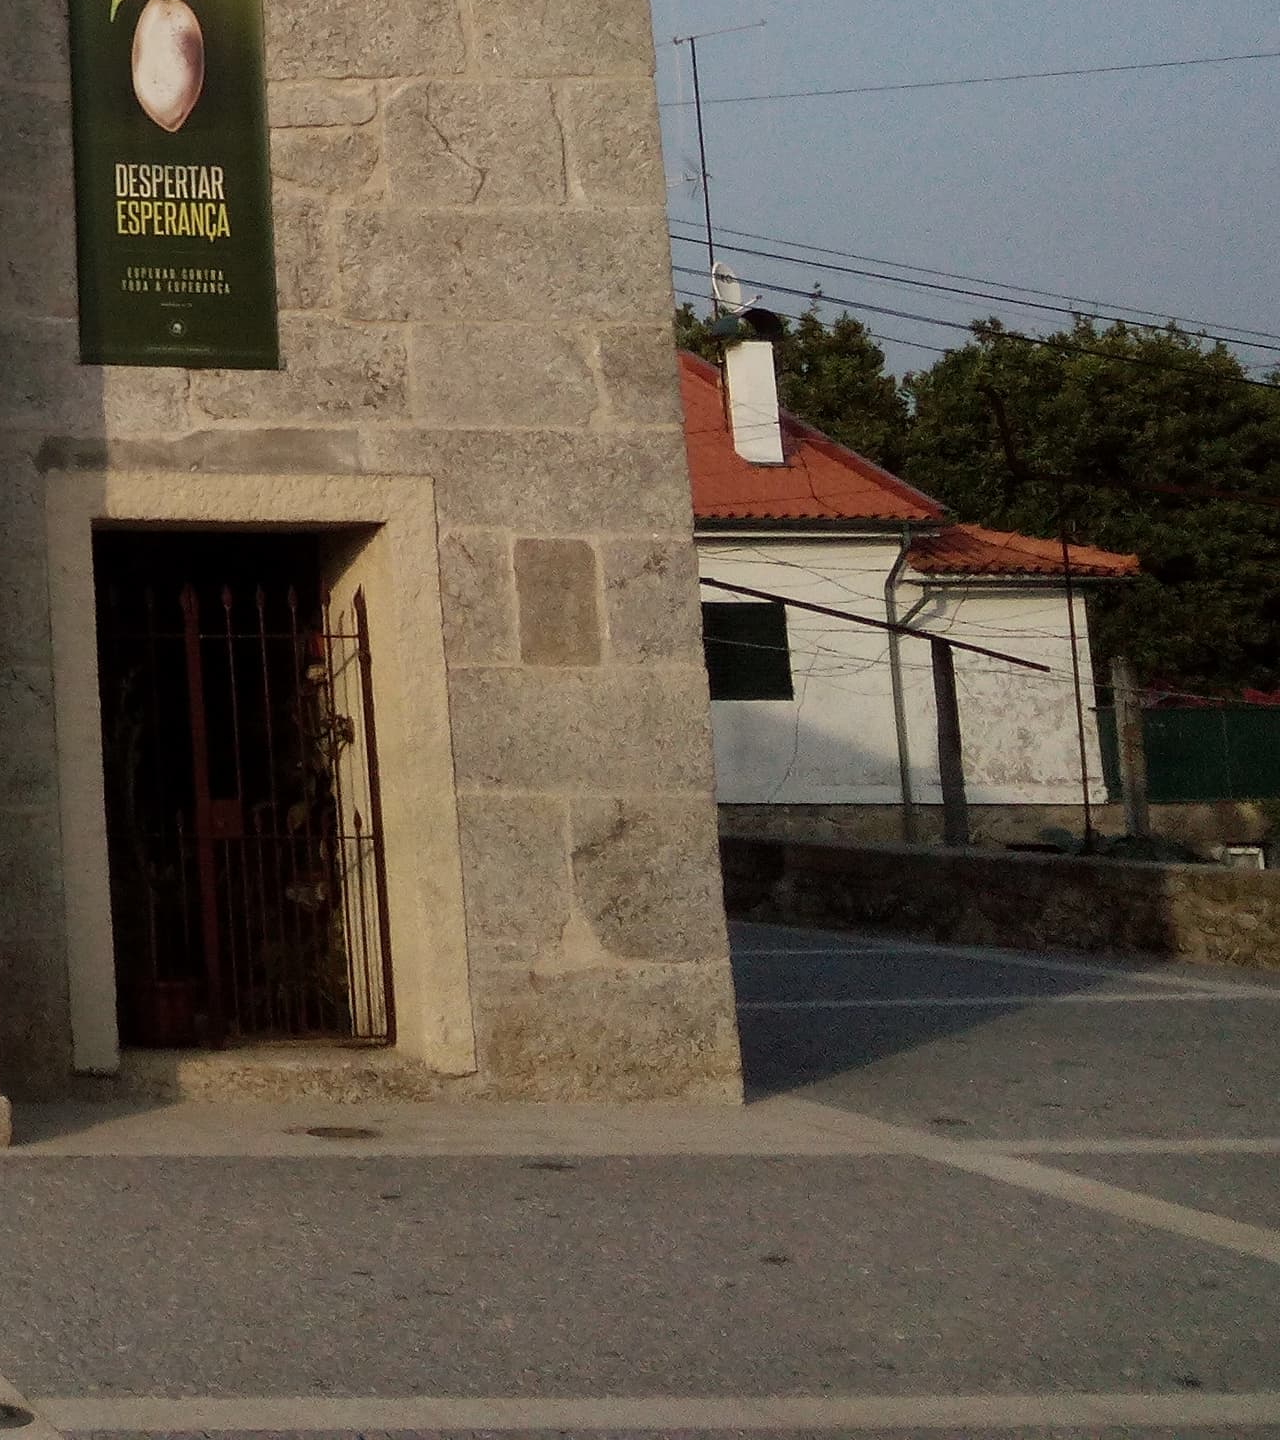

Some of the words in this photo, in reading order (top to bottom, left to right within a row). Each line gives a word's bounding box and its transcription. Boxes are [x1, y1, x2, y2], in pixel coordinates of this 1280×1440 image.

[115, 163, 224, 200] DESPERTAR
[117, 200, 230, 243] ESPERANÇA
[121, 279, 149, 292] TODA
[155, 280, 161, 292] A
[168, 280, 231, 295] ESPERANÇA
